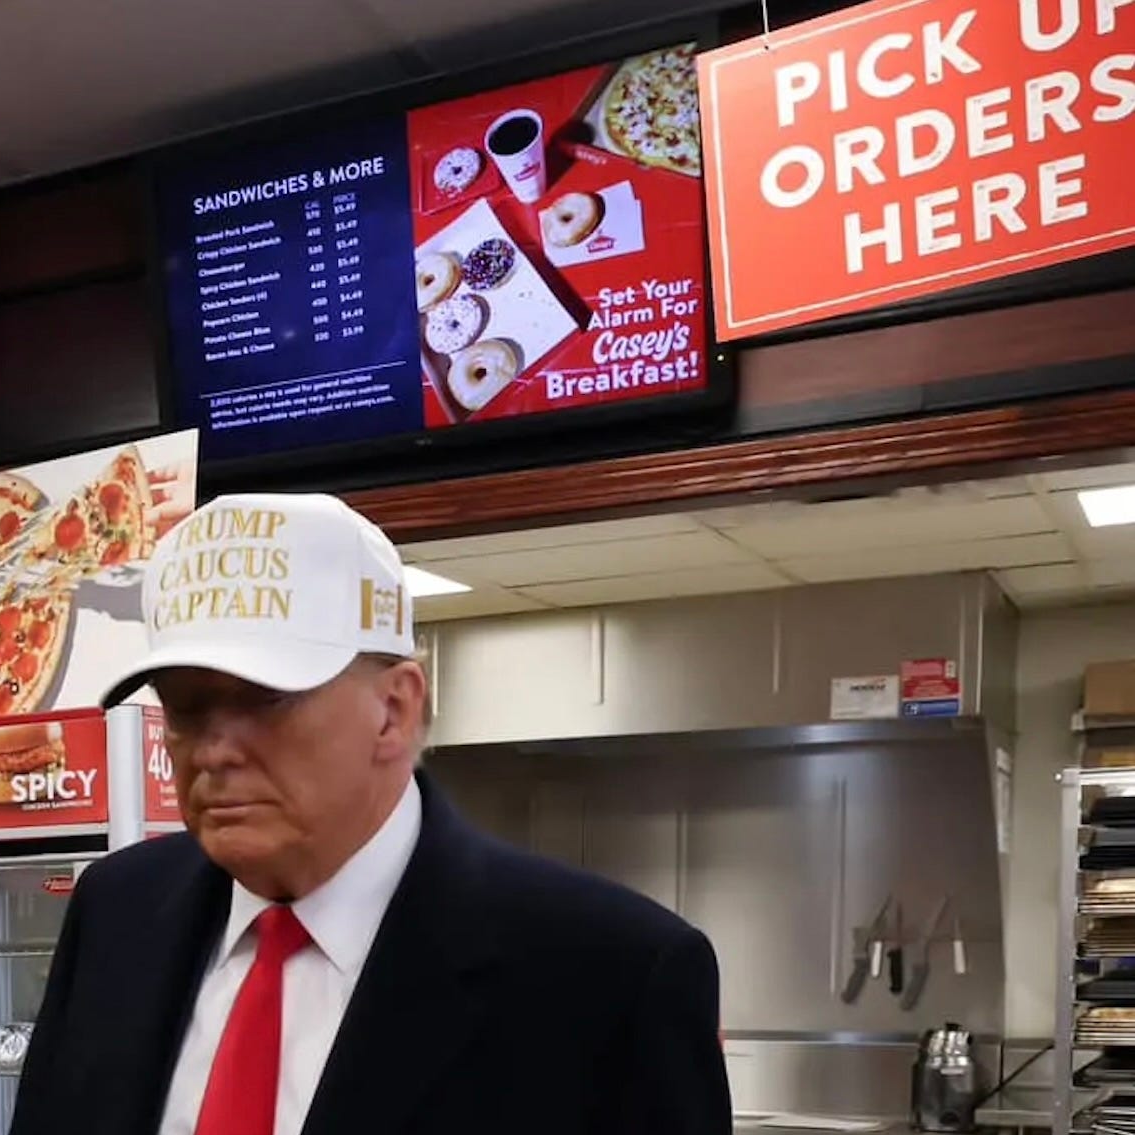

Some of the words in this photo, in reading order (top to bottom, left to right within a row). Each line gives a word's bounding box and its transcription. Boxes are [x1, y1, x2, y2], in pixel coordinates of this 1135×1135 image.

[775, 10, 982, 127] PICK
[760, 54, 1135, 208] ORDERS
[193, 174, 309, 215] SANDWICHES
[312, 170, 326, 189] &
[329, 156, 386, 185] MORE
[843, 153, 1088, 273] HERE
[587, 308, 654, 331] Alarm
[661, 297, 698, 318] For
[598, 285, 635, 310] Set
[640, 277, 692, 300] Your
[593, 321, 690, 365] Casey's
[546, 351, 699, 400] Breakfast!
[160, 547, 289, 591] CAUCUS
[153, 587, 294, 631] CAPTAIN
[10, 768, 97, 802] SPICY
